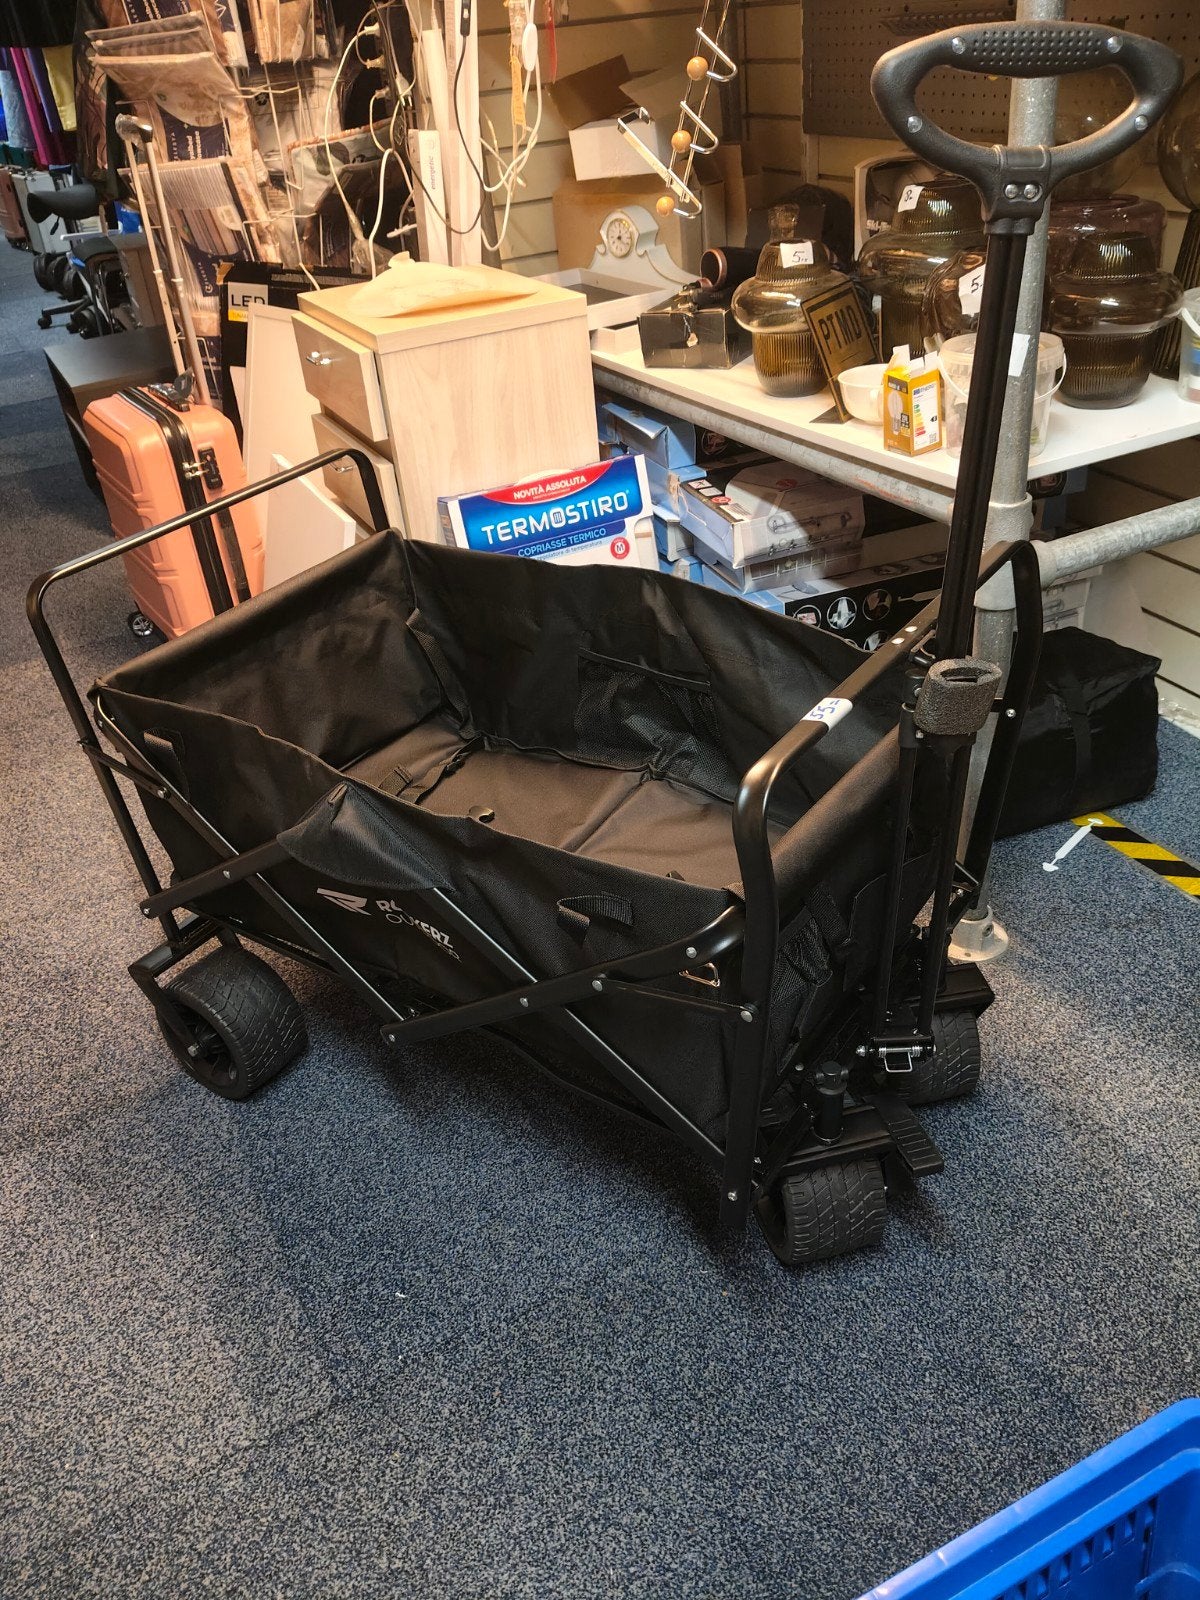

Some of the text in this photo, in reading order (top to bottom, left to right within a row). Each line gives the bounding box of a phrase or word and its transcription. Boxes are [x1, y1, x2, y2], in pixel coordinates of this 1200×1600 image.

[818, 305, 862, 354] PTMD
[513, 484, 545, 501] NOVITÀ
[545, 475, 587, 492] ASSOLUTA
[481, 491, 629, 545] TERMOSTIRO
[518, 528, 607, 558] COPRIASSE TERMICO
[570, 540, 603, 552] temperatura
[616, 543, 624, 552] M
